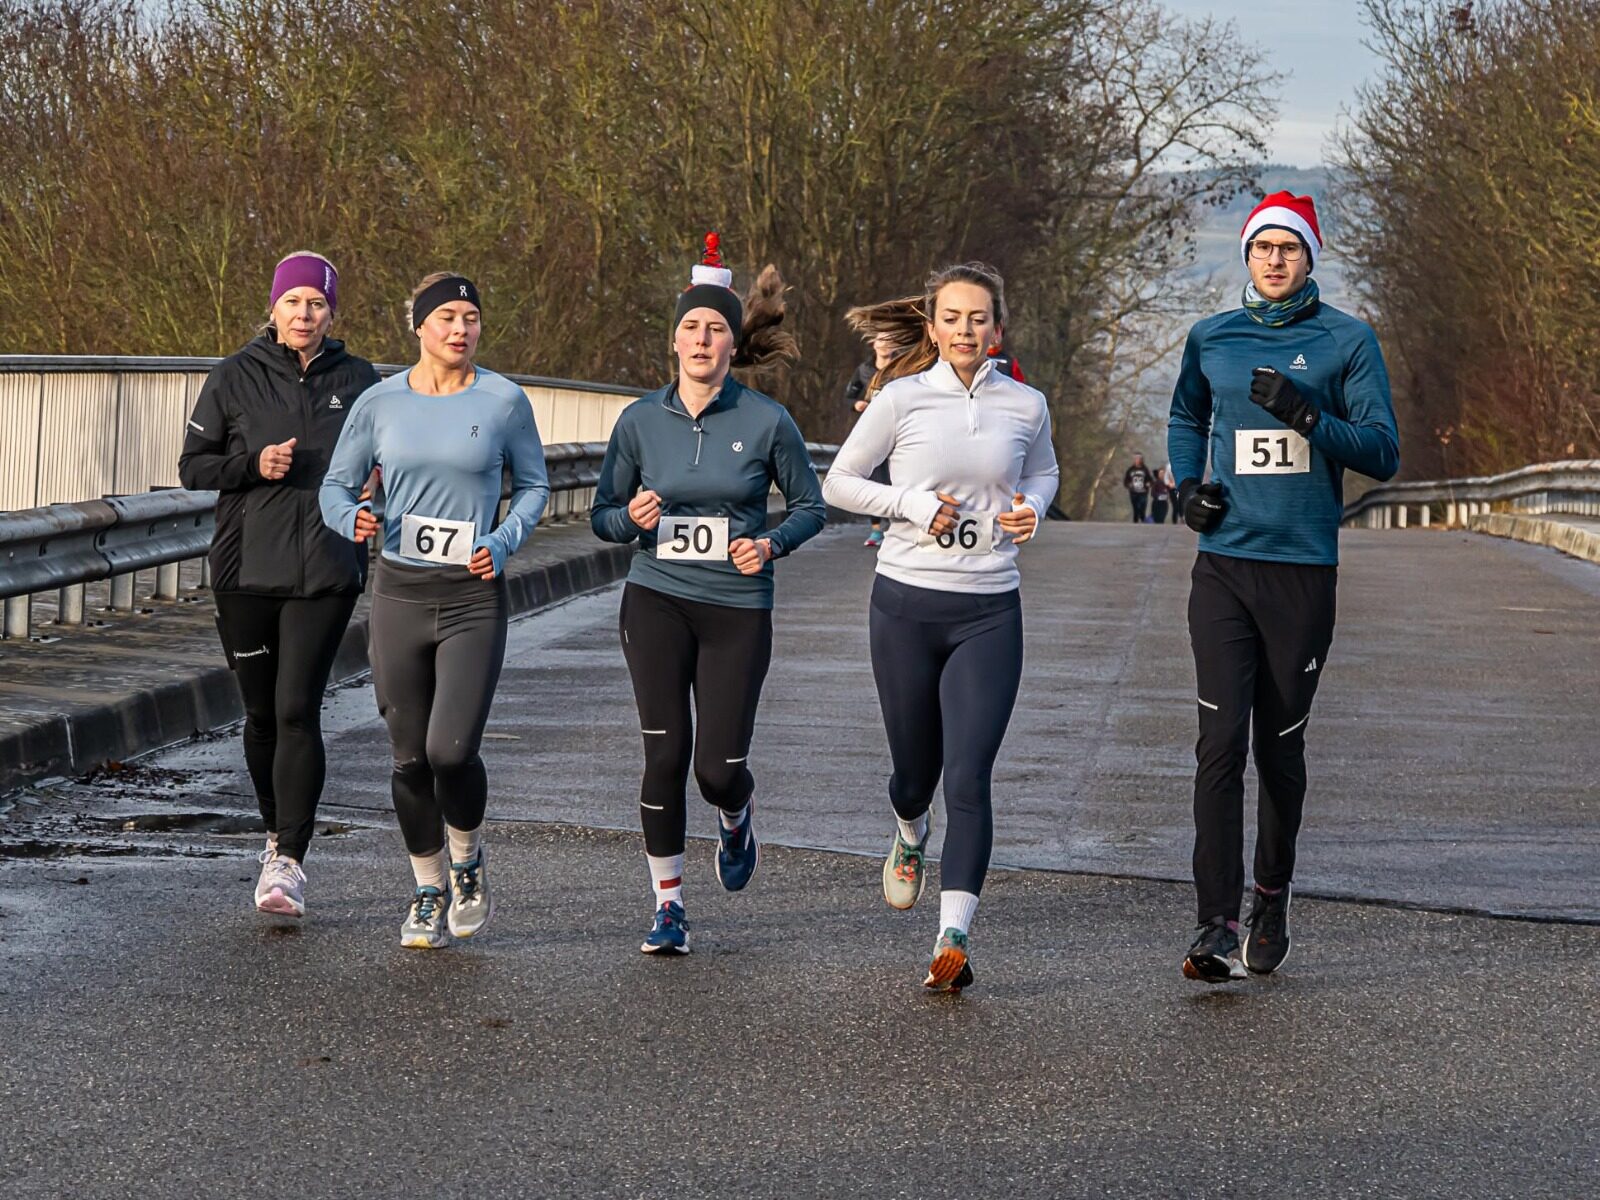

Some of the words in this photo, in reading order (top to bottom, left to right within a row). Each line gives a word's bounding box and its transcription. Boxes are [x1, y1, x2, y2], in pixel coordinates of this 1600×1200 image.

[1251, 437, 1294, 468] 51
[415, 524, 459, 557] 67
[671, 523, 713, 554] 50
